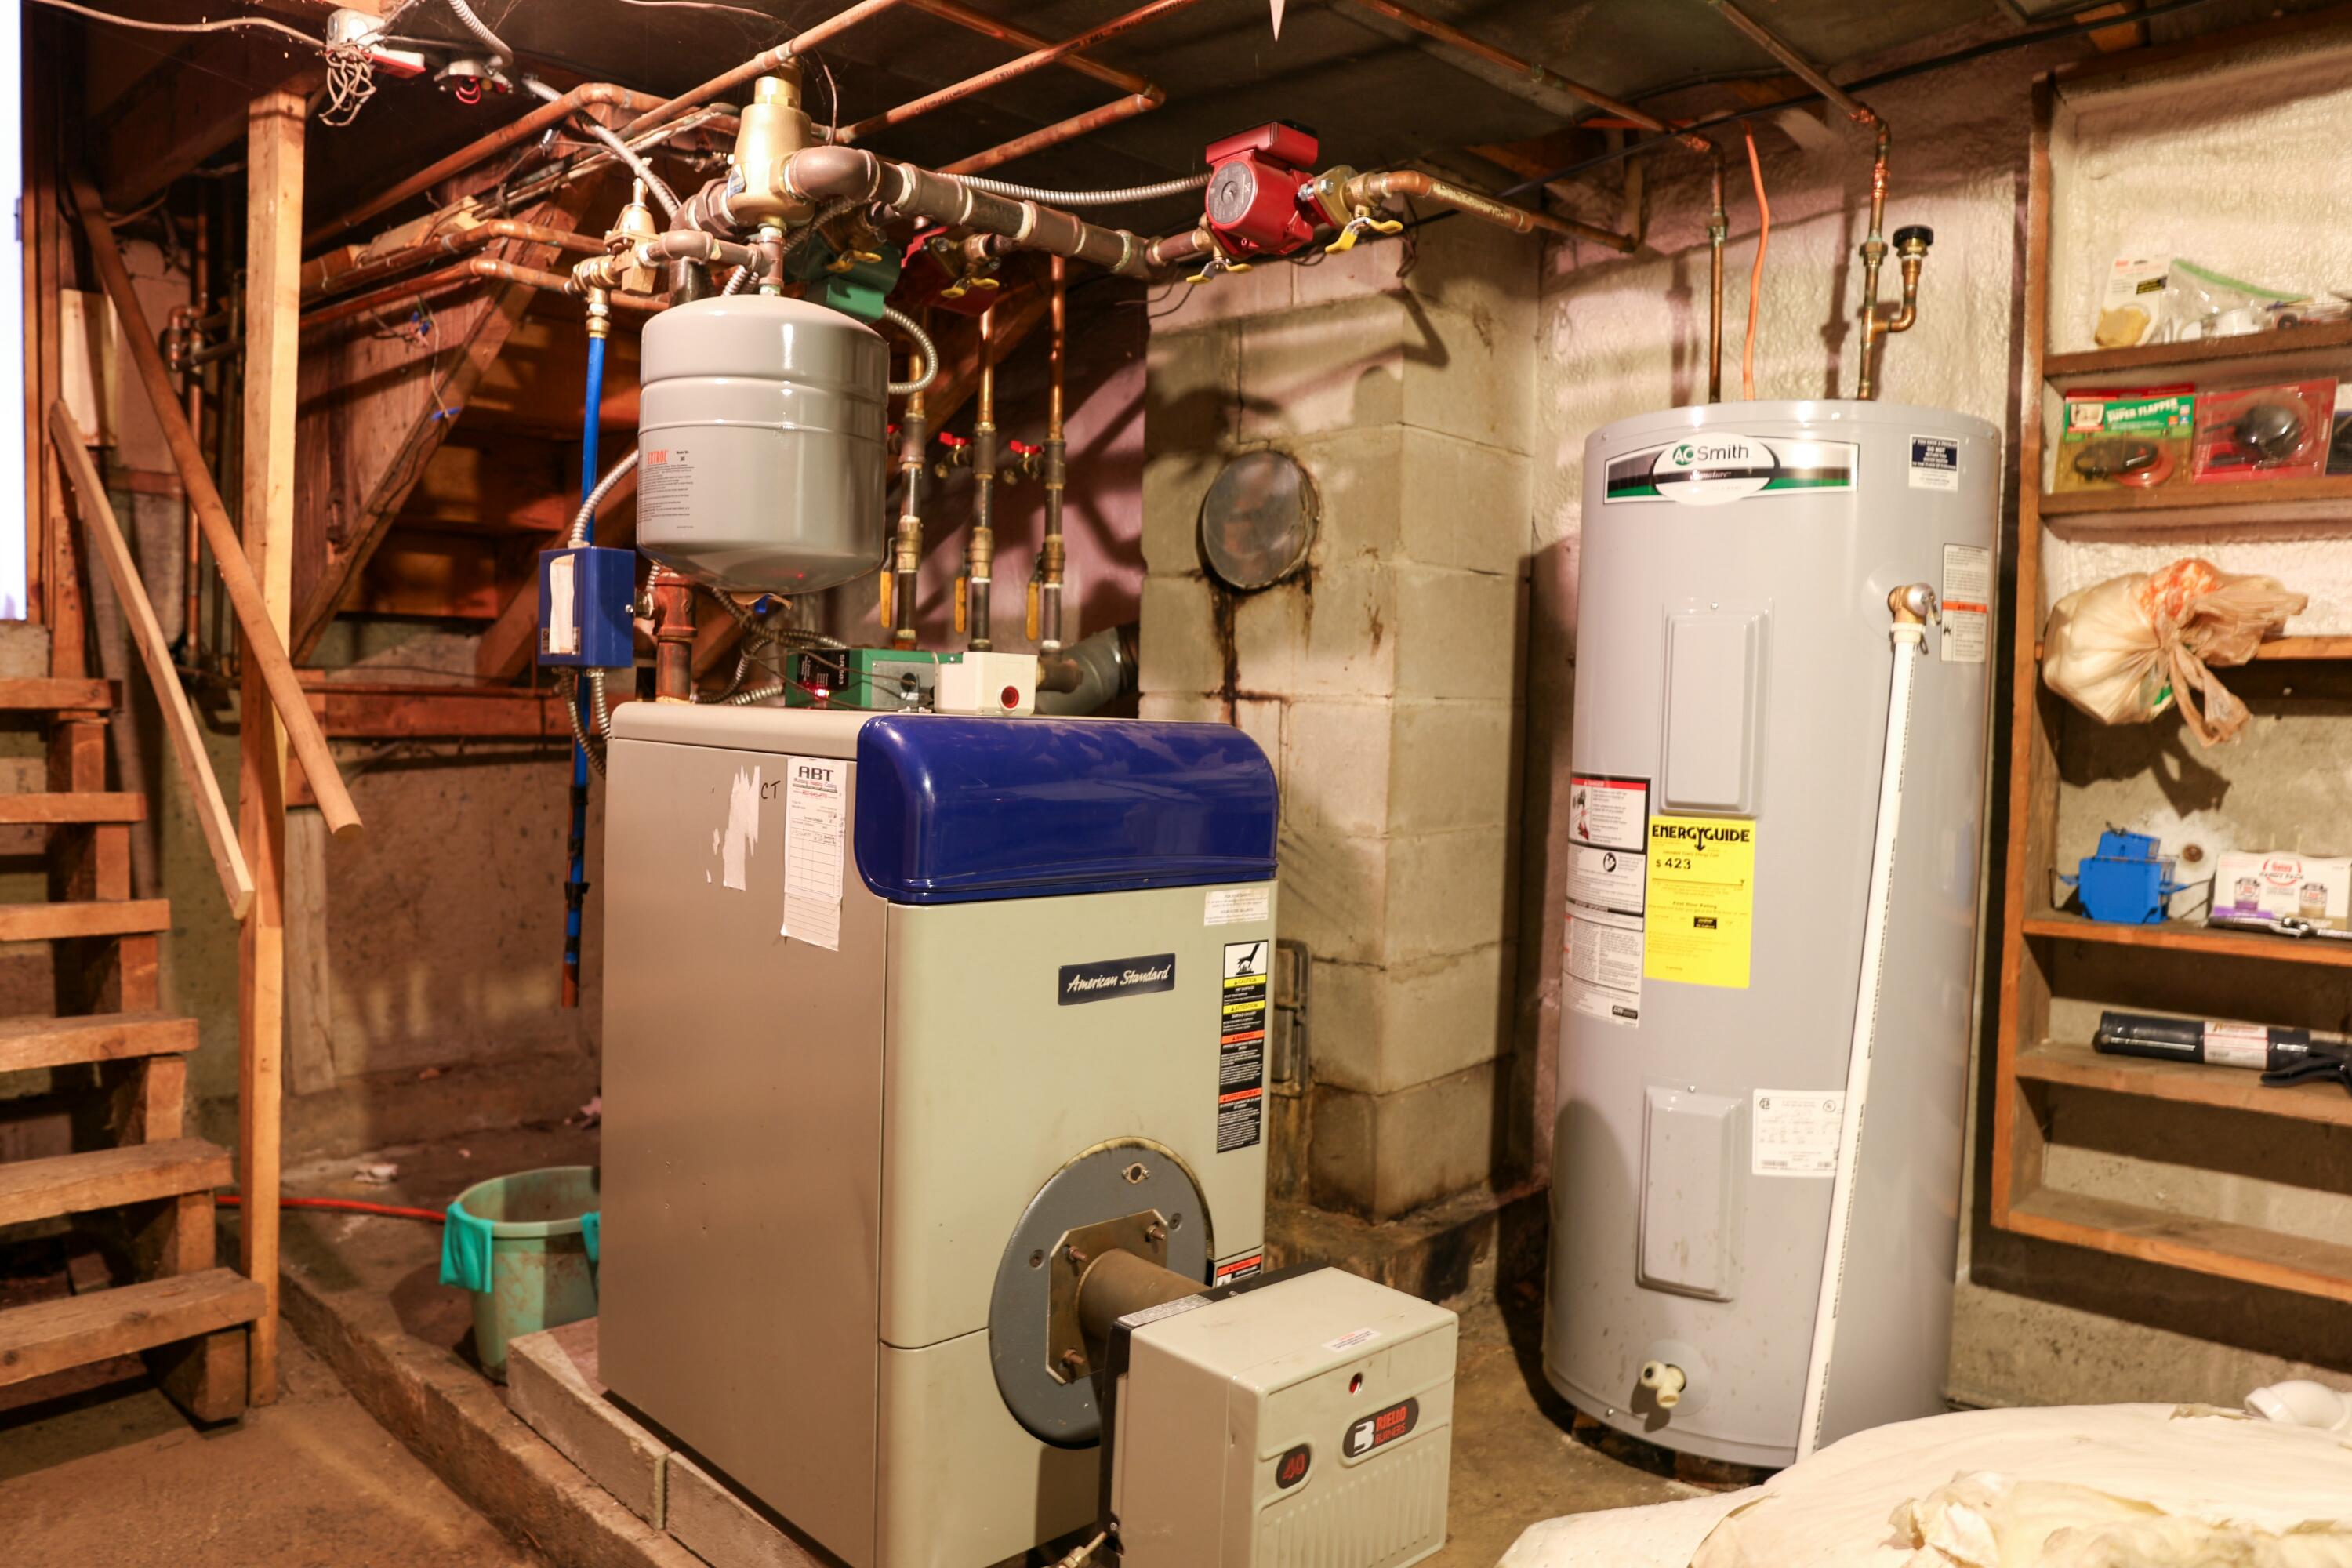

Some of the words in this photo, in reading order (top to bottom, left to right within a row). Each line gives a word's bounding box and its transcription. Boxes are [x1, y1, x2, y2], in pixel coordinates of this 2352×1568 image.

[2138, 397, 2178, 417] FLAPPER
[1697, 440, 1748, 461] Smith
[799, 765, 834, 782] ABT
[760, 780, 781, 800] CT
[1652, 824, 1750, 844] ENERGYGUIDE
[1664, 857, 1691, 869] 423
[1066, 974, 1118, 993] American
[1119, 964, 1172, 986] Standard
[1376, 1406, 1407, 1431] RIELLO
[1282, 1453, 1306, 1481] 40
